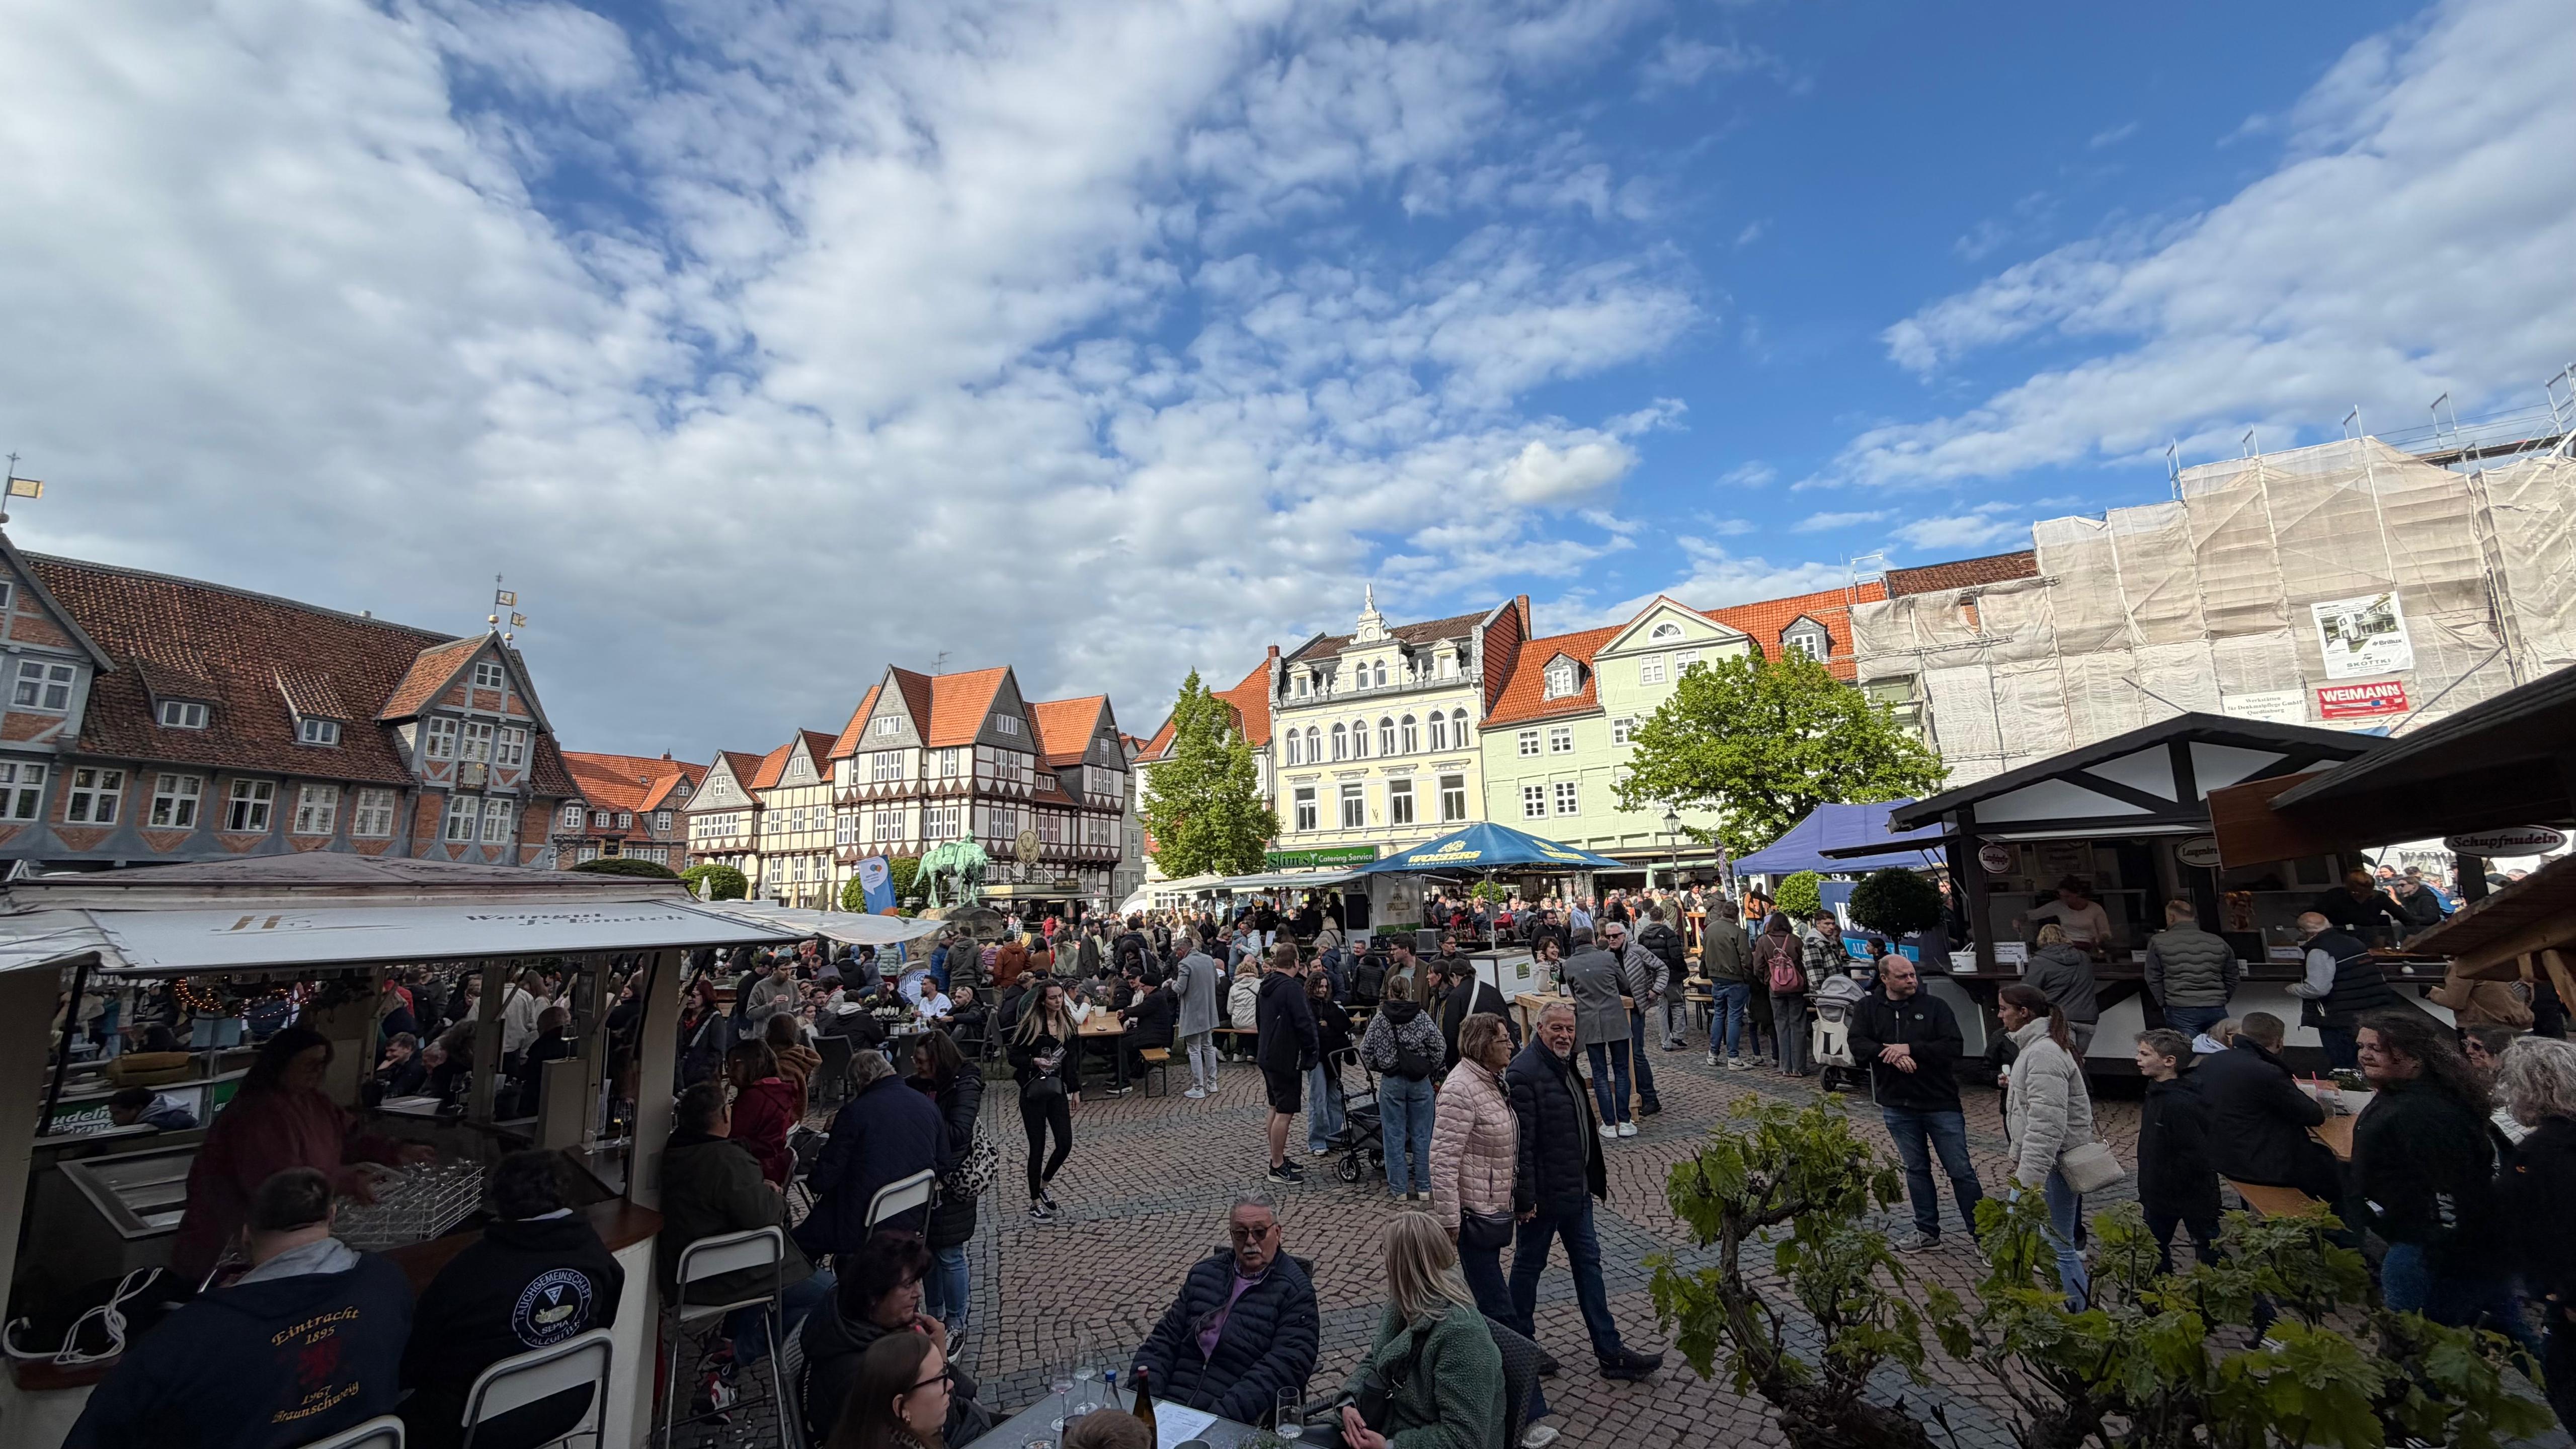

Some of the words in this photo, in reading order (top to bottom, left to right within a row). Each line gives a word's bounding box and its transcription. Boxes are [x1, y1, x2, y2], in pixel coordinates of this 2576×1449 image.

[2347, 659, 2391, 668] SKOTTKI
[2321, 685, 2401, 702] WEIMANN
[2452, 833, 2559, 849] Schupfnudeln
[1408, 851, 1482, 863] WOLTERS
[2183, 846, 2218, 857] Laugenbr
[1269, 853, 1309, 868] Slim's
[1318, 855, 1347, 863] Catering
[1348, 853, 1374, 861] Service
[570, 915, 687, 924] Emrich
[515, 1271, 591, 1323] TAUCHGEMEINSCHAFT
[271, 1306, 360, 1346] Eintracht
[541, 1320, 569, 1334] SEPIA
[305, 1324, 336, 1345] 1895
[271, 1381, 360, 1424] Braunschweig
[301, 1385, 332, 1405] 1967
